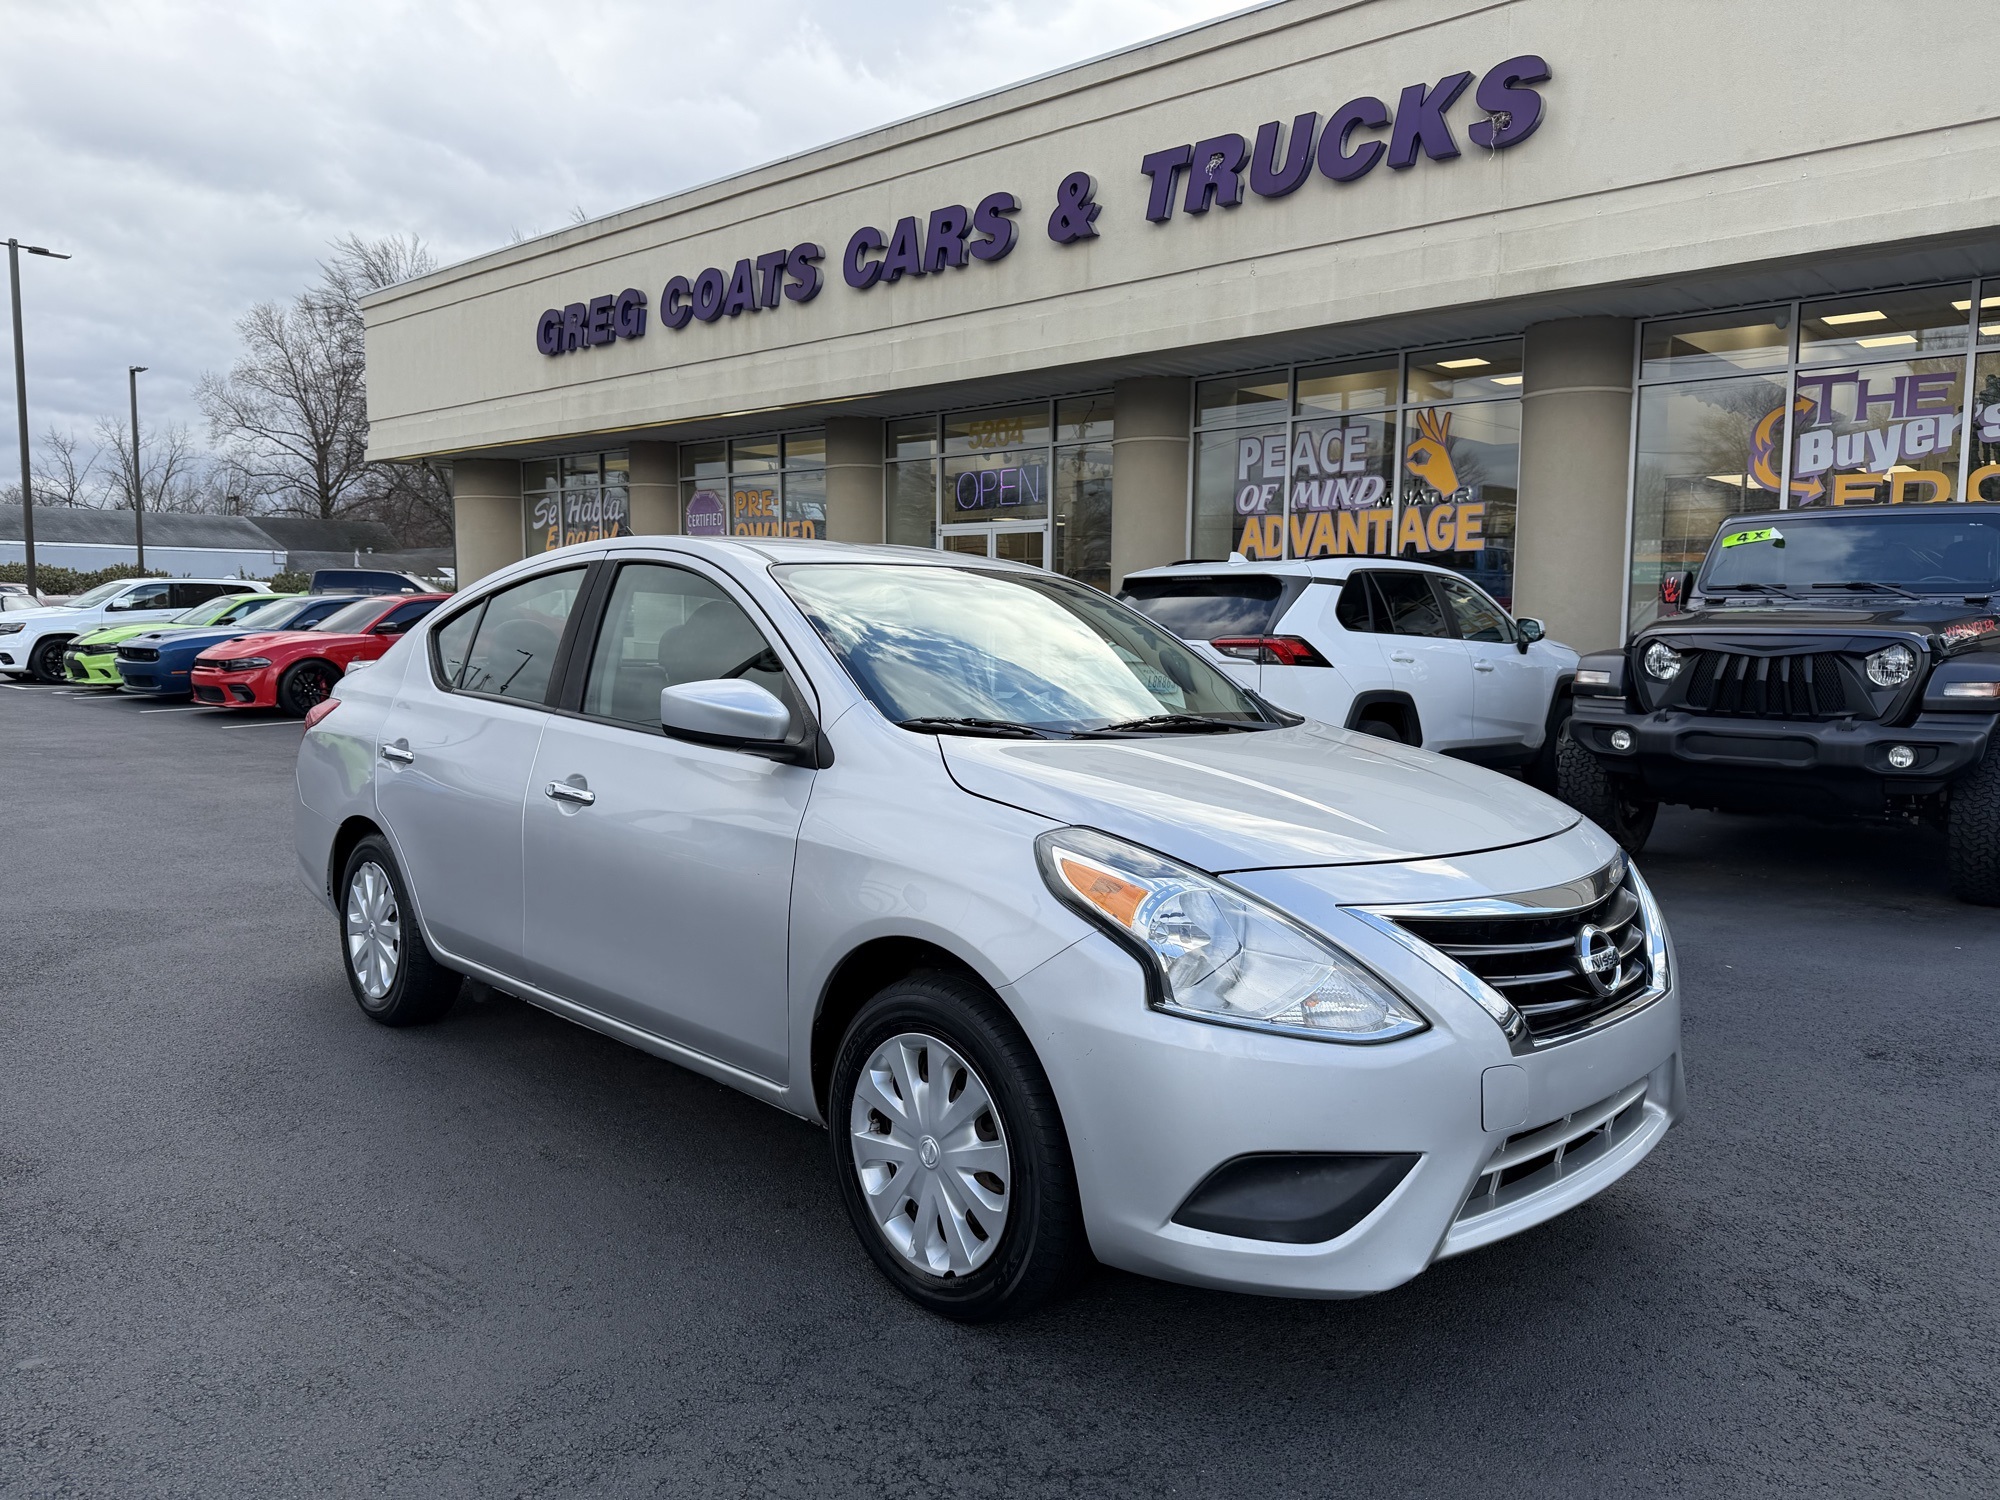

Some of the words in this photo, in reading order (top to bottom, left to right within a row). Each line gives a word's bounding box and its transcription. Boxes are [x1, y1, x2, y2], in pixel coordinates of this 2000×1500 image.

[537, 287, 647, 356] GREG
[661, 242, 825, 329] COATS
[843, 192, 1021, 289] CARS
[1048, 171, 1102, 244] &
[1141, 55, 1552, 223] TRUCKS
[1797, 370, 1958, 427] THE
[1238, 425, 1370, 481] PEACE
[957, 466, 1039, 509] OPEN
[1236, 483, 1280, 515] OF
[1290, 476, 1386, 513] MIND
[533, 497, 558, 530] Se
[567, 490, 624, 523] Habla
[687, 512, 723, 527] CERTIFIED
[1237, 502, 1486, 559] ADVANTAGE
[1944, 619, 1998, 638] WRANGLER
